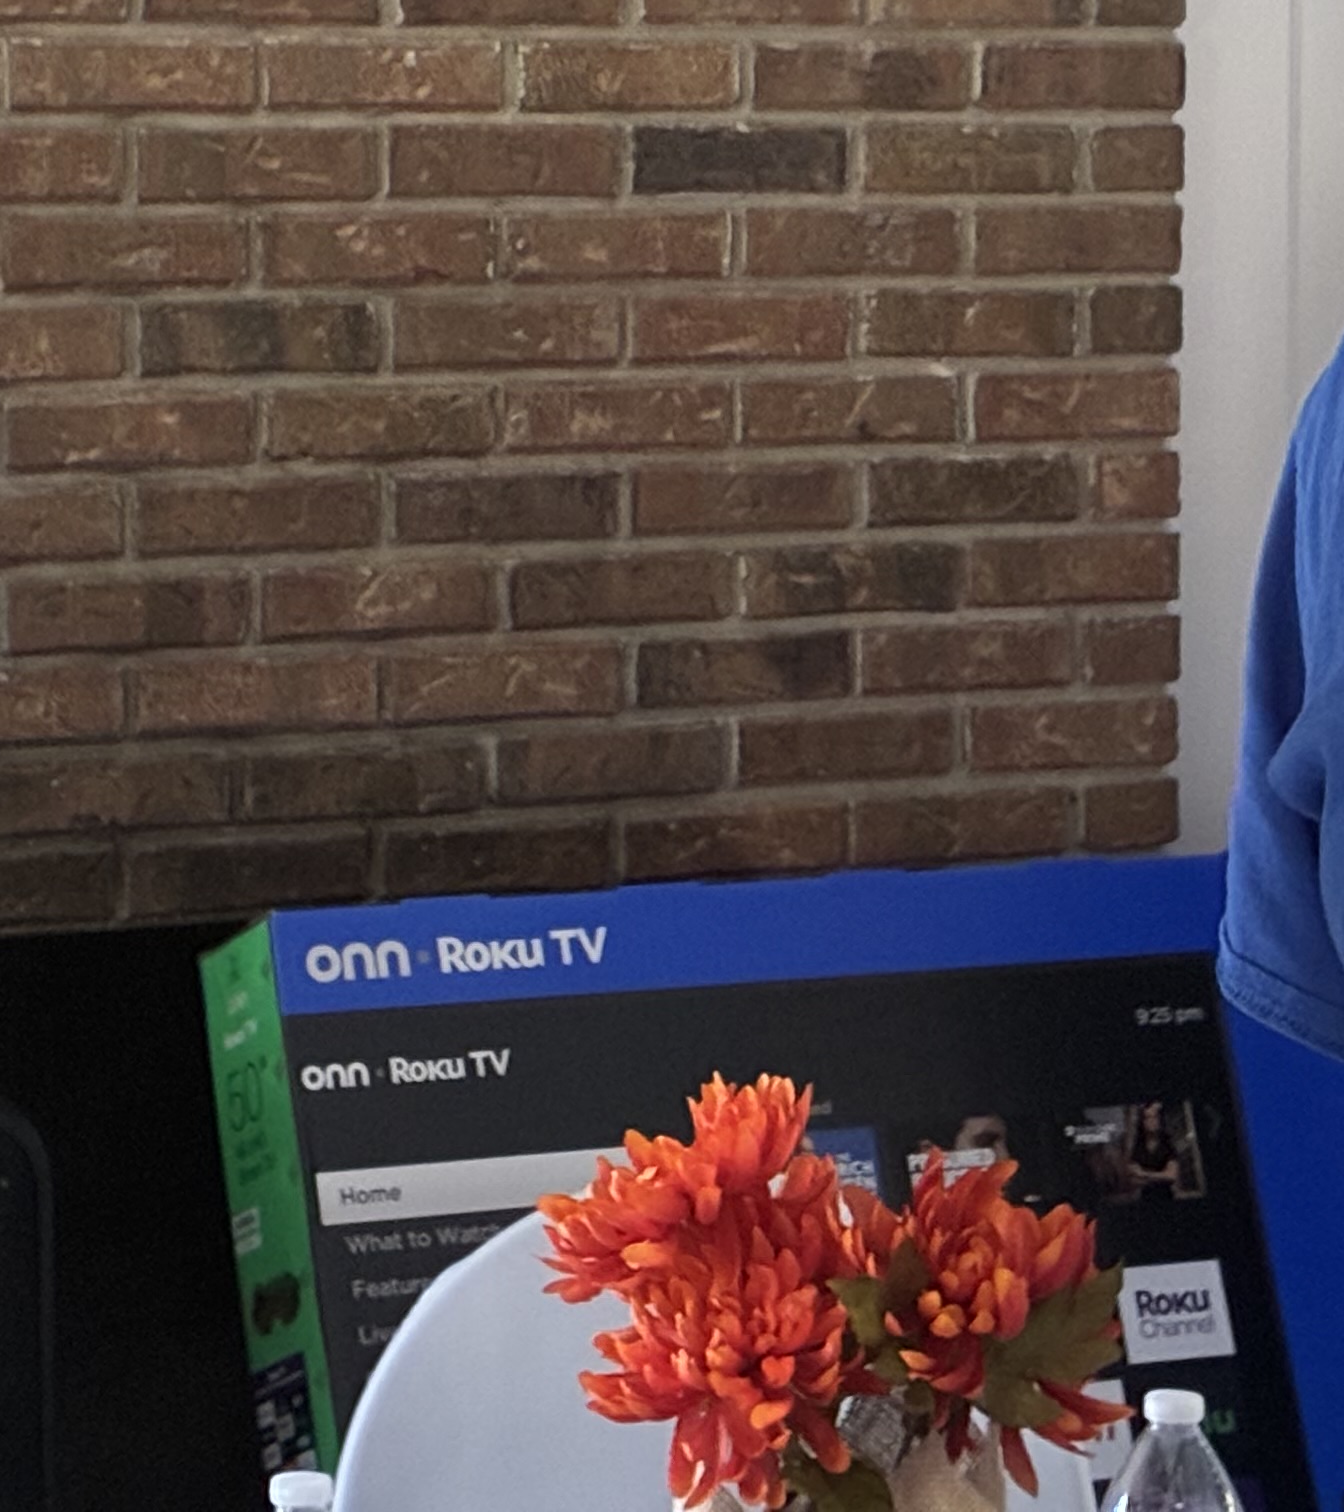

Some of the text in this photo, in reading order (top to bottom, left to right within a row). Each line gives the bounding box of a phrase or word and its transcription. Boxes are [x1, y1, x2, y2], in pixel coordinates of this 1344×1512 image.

[306, 940, 412, 983] onn
[548, 926, 606, 966] TV
[301, 1062, 370, 1090] onn
[468, 1048, 510, 1077] TV
[339, 1186, 402, 1205] Home
[344, 1231, 403, 1255] What
[408, 1231, 432, 1248] to
[1139, 1317, 1216, 1339] Channel
